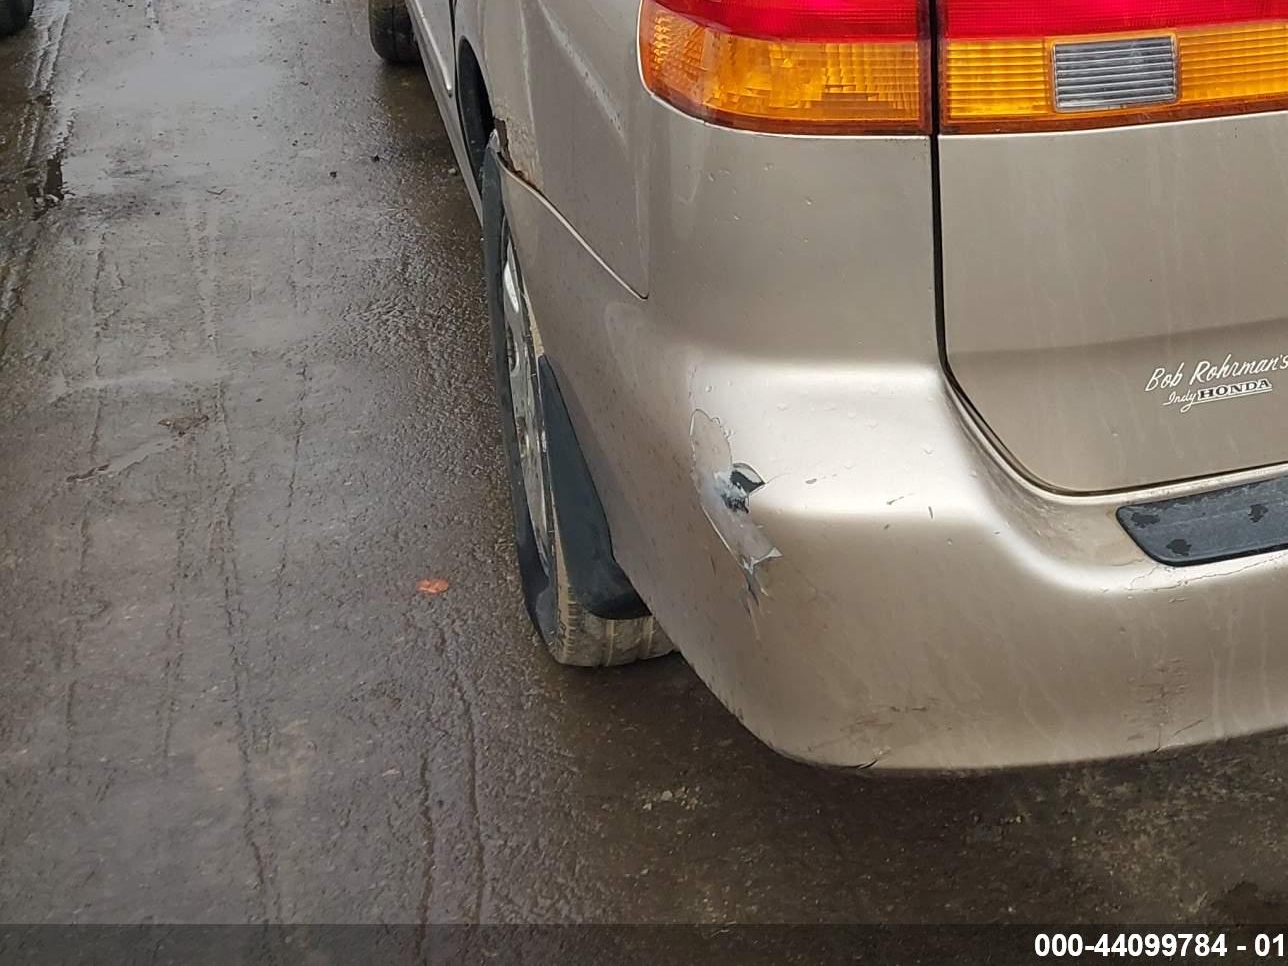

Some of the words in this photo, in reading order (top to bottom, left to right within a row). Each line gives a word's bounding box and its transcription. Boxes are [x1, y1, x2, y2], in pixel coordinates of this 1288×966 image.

[1144, 361, 1185, 392] Bob
[1163, 390, 1200, 413] Indy
[1198, 378, 1273, 401] HONDA
